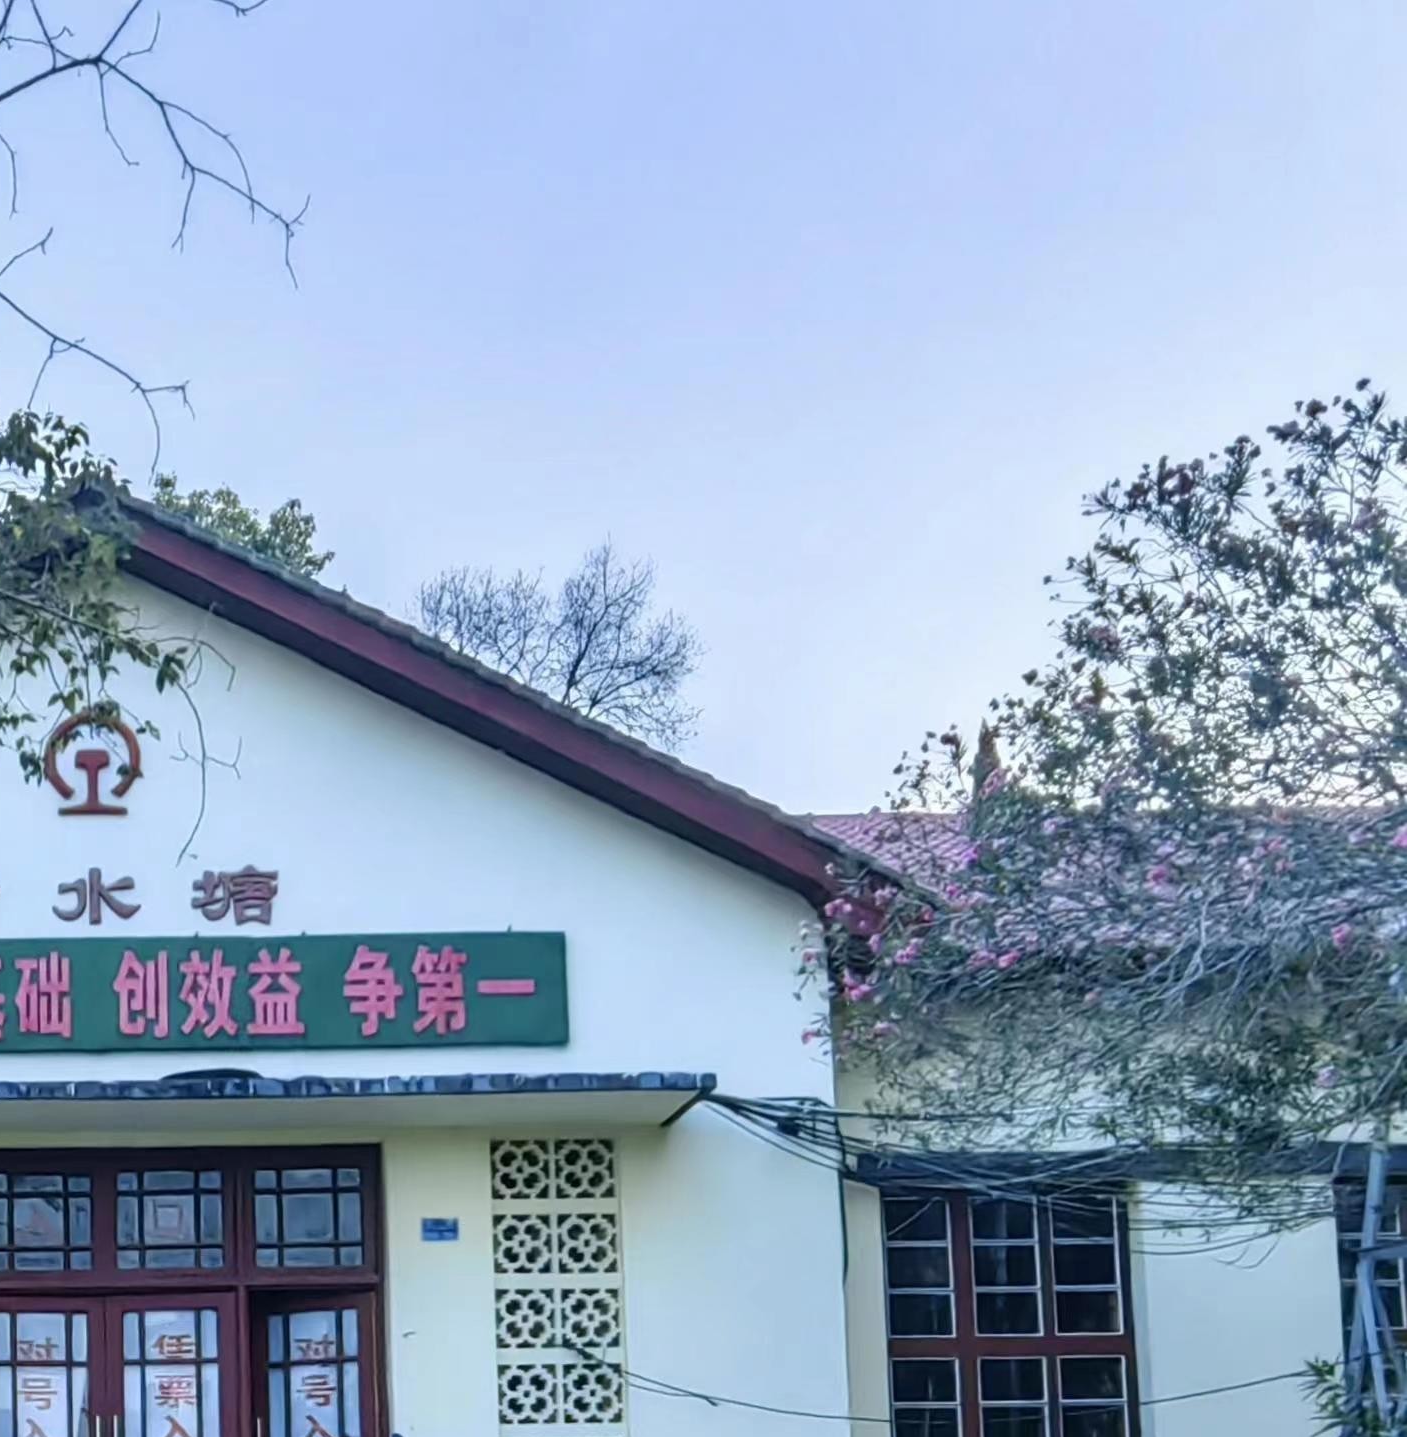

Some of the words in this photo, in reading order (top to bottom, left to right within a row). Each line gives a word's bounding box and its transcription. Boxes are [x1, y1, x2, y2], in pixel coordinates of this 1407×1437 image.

[112, 948, 306, 1038] 创效益
[342, 945, 536, 1037] 争第一
